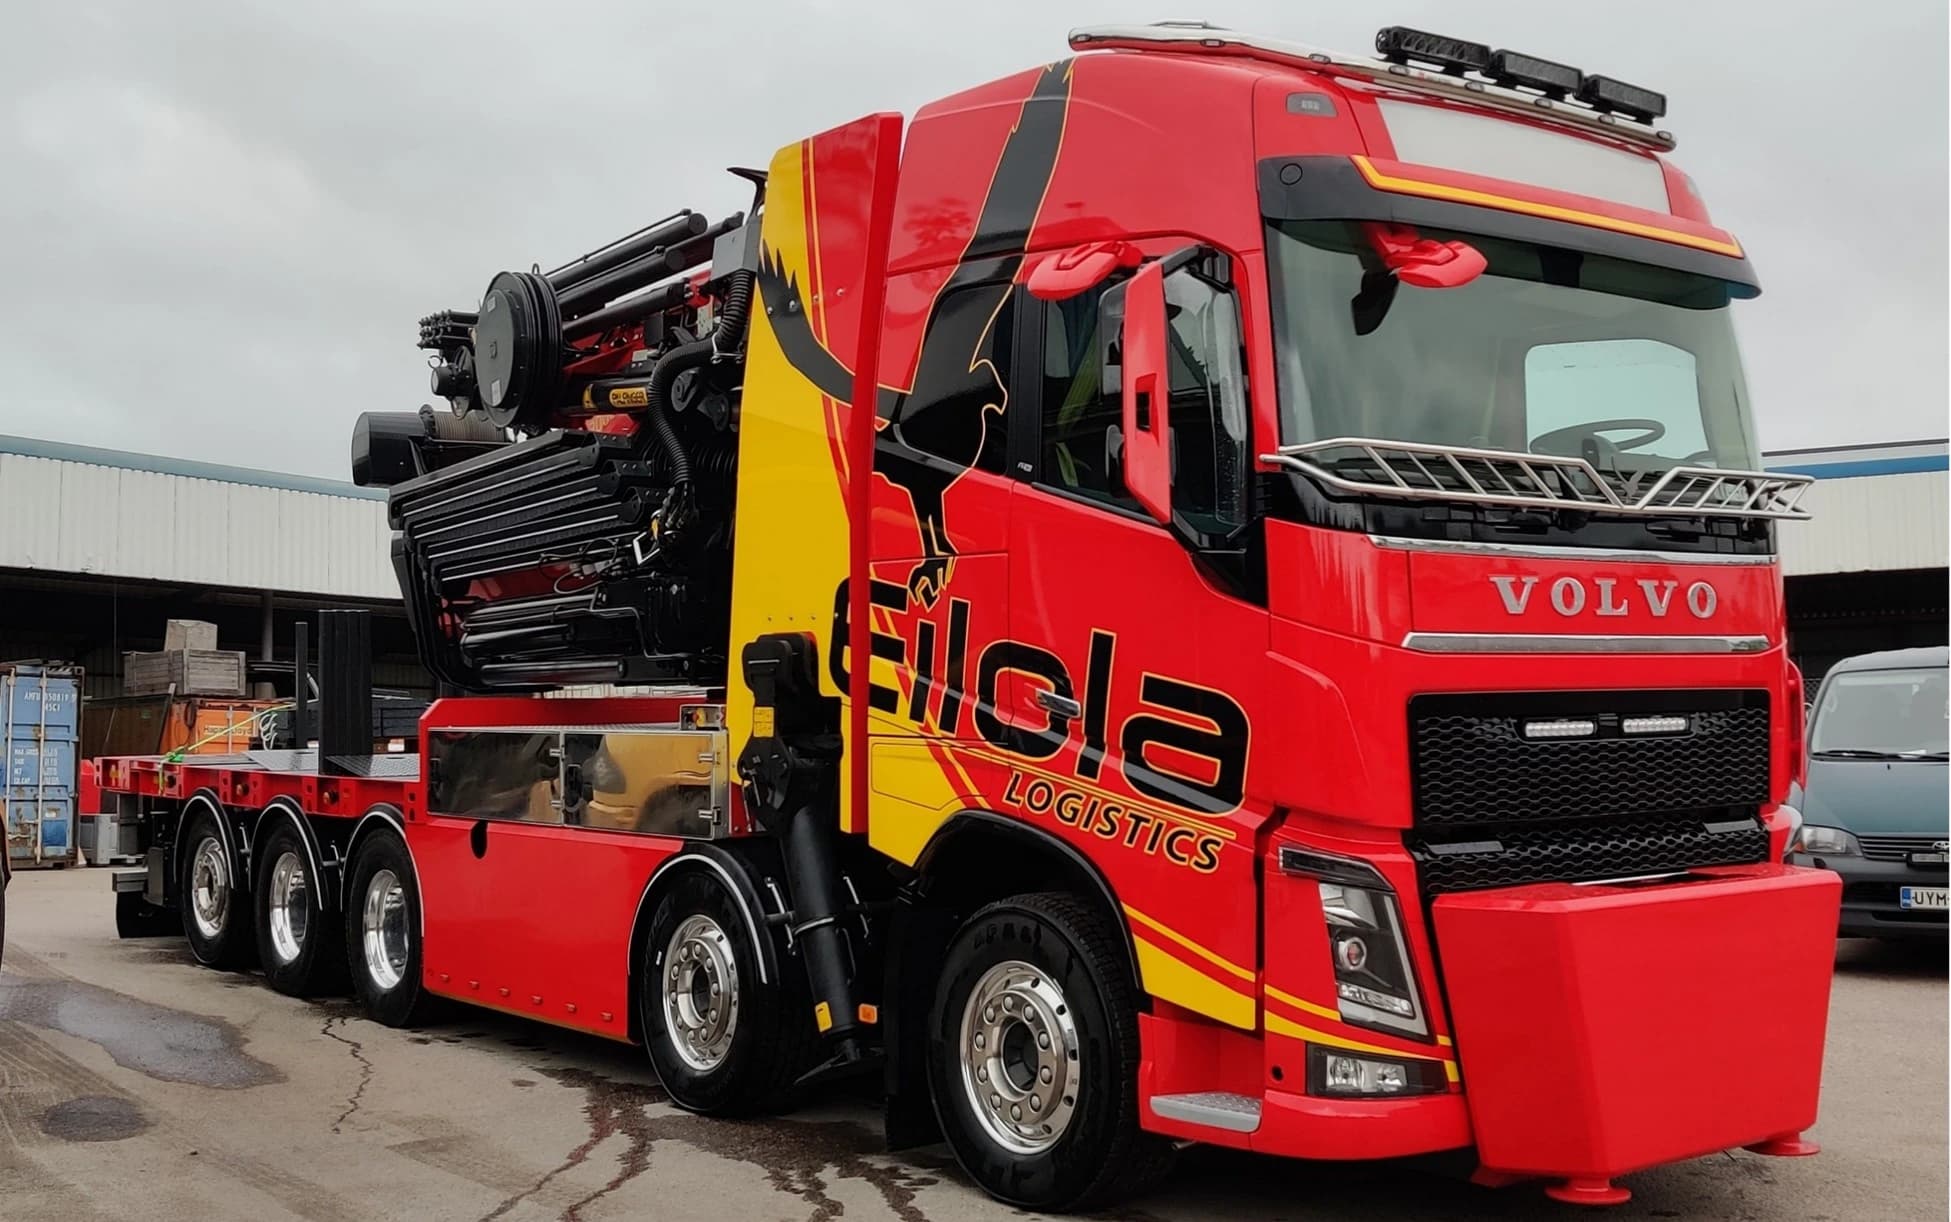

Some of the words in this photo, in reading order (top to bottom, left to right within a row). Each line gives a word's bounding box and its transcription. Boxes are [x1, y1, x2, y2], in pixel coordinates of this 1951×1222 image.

[1489, 575, 1717, 618] VOLVO
[829, 577, 1252, 818] Eilola
[1002, 770, 1224, 873] LOGISTICS
